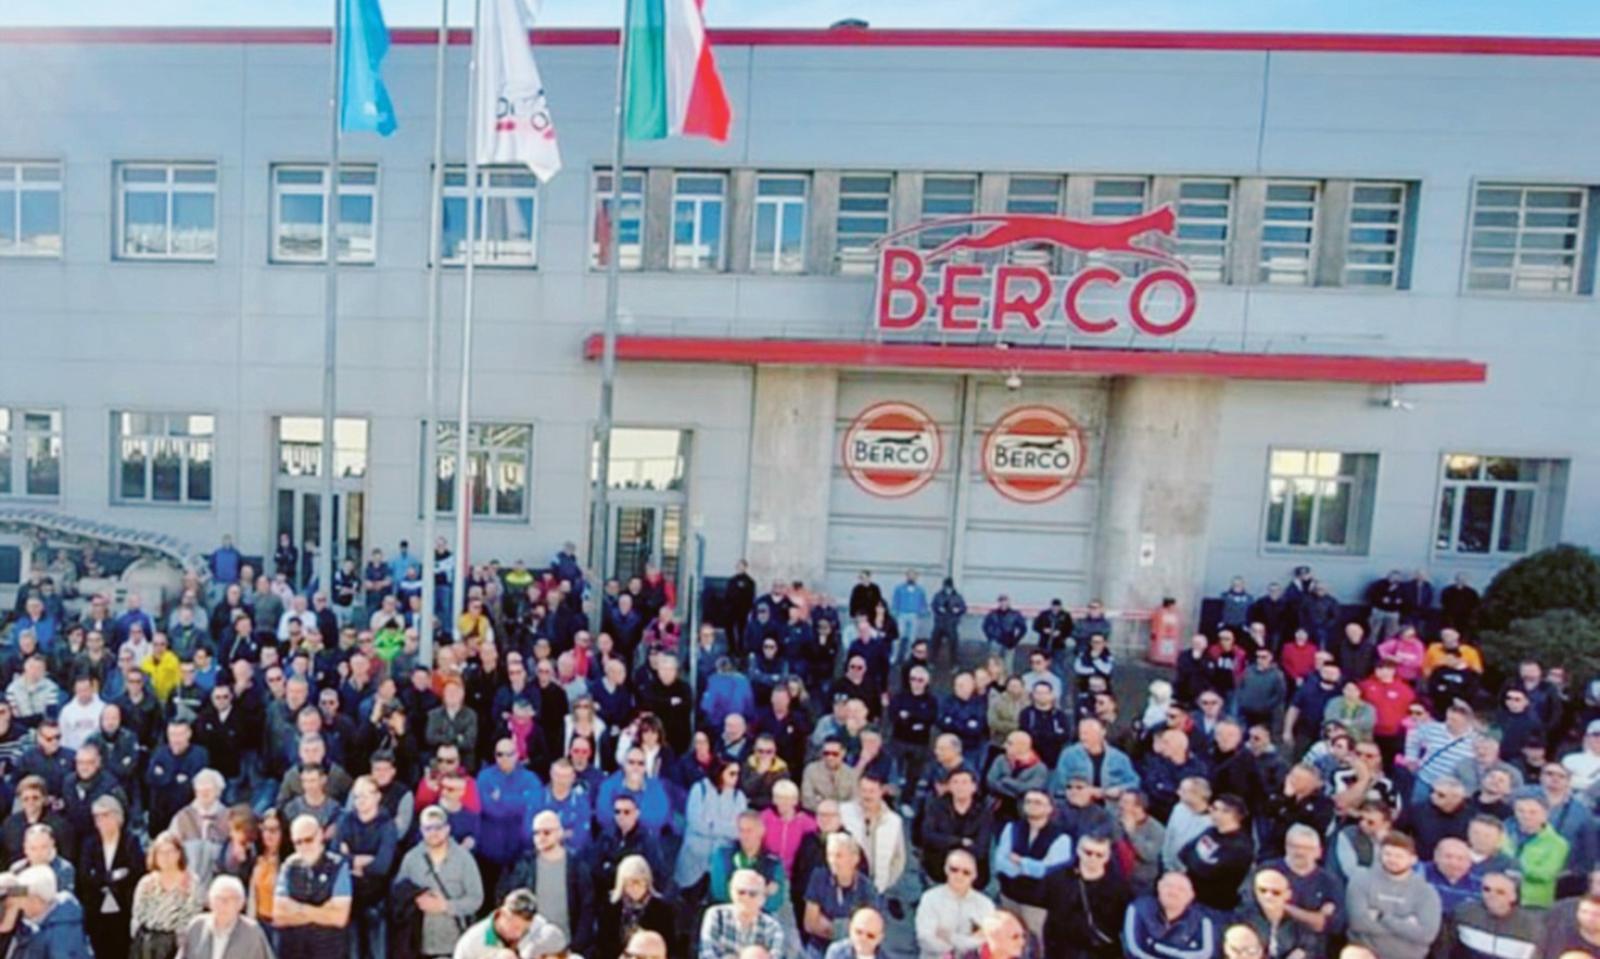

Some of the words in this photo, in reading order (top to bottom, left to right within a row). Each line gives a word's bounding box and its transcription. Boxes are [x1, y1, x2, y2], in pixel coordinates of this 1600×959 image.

[878, 248, 1197, 335] BERCO
[854, 440, 929, 465] BERCO
[994, 445, 1071, 470] BERCO
